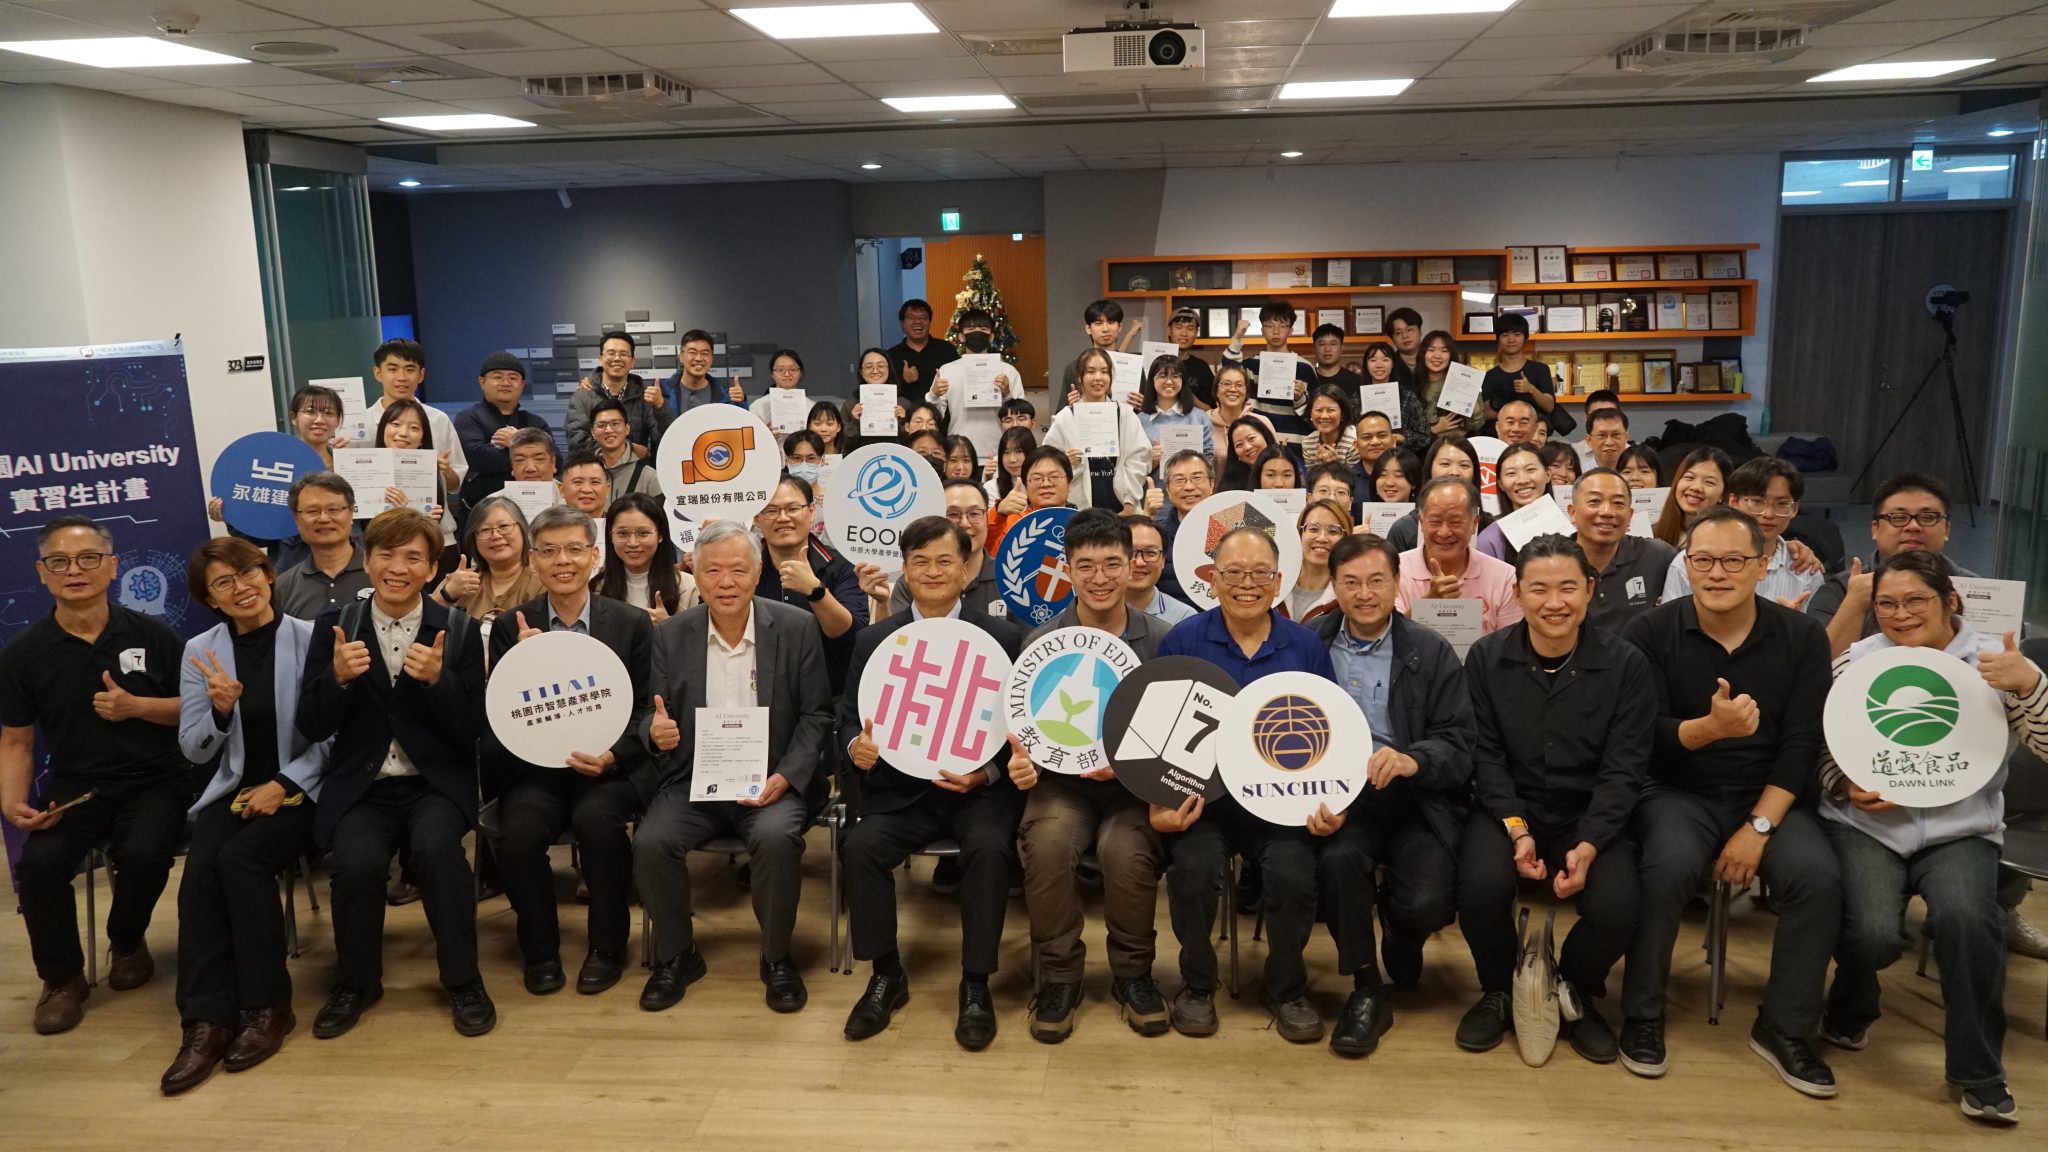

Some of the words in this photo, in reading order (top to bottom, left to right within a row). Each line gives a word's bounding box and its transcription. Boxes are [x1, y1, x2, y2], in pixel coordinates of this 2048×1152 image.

[50, 444, 180, 472] University
[10, 477, 150, 514] 實習生計畫
[231, 483, 289, 506] 永雄建
[676, 490, 767, 506] 宣瑞股份有限公司
[999, 604, 1005, 613] 7
[134, 655, 142, 666] 7
[1009, 634, 1067, 719] MINISTRY
[1073, 633, 1101, 649] OF
[510, 687, 612, 720] 桃園市智慧產業學院
[1192, 692, 1213, 709] No.
[1184, 709, 1221, 754] 7
[1018, 725, 1100, 770] 教育部
[1160, 775, 1202, 800] Integration
[1167, 768, 1206, 791] Algorithm
[1242, 779, 1351, 799] SUNCHUN
[1888, 780, 1926, 788] DAWN
[1929, 779, 1956, 788] LINK
